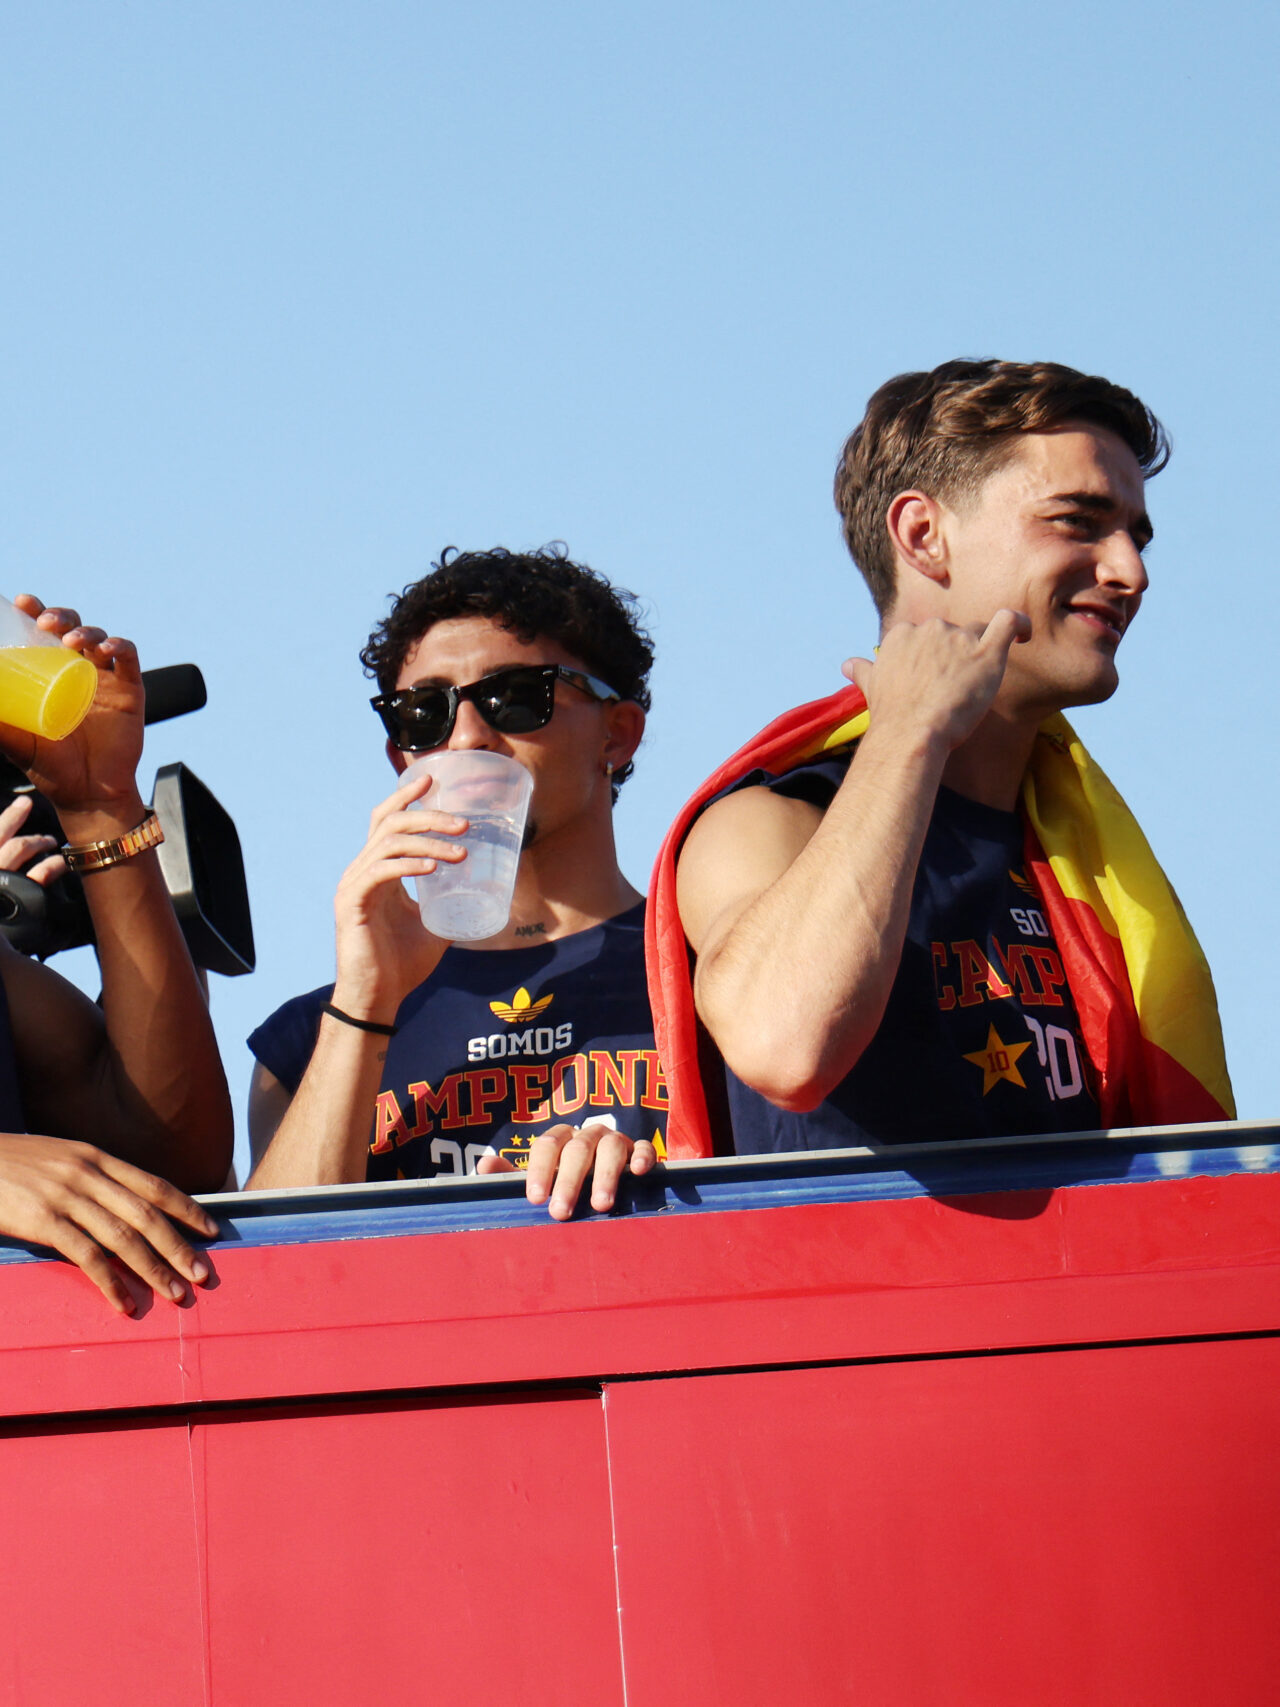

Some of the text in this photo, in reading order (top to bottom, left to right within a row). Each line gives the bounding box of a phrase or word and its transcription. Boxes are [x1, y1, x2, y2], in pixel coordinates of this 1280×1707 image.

[1009, 907, 1050, 937] SO
[930, 934, 1066, 1011] CAMP
[467, 1022, 573, 1063] SOMOS
[986, 1049, 1011, 1073] 10
[369, 1049, 668, 1156] AMPEONE
